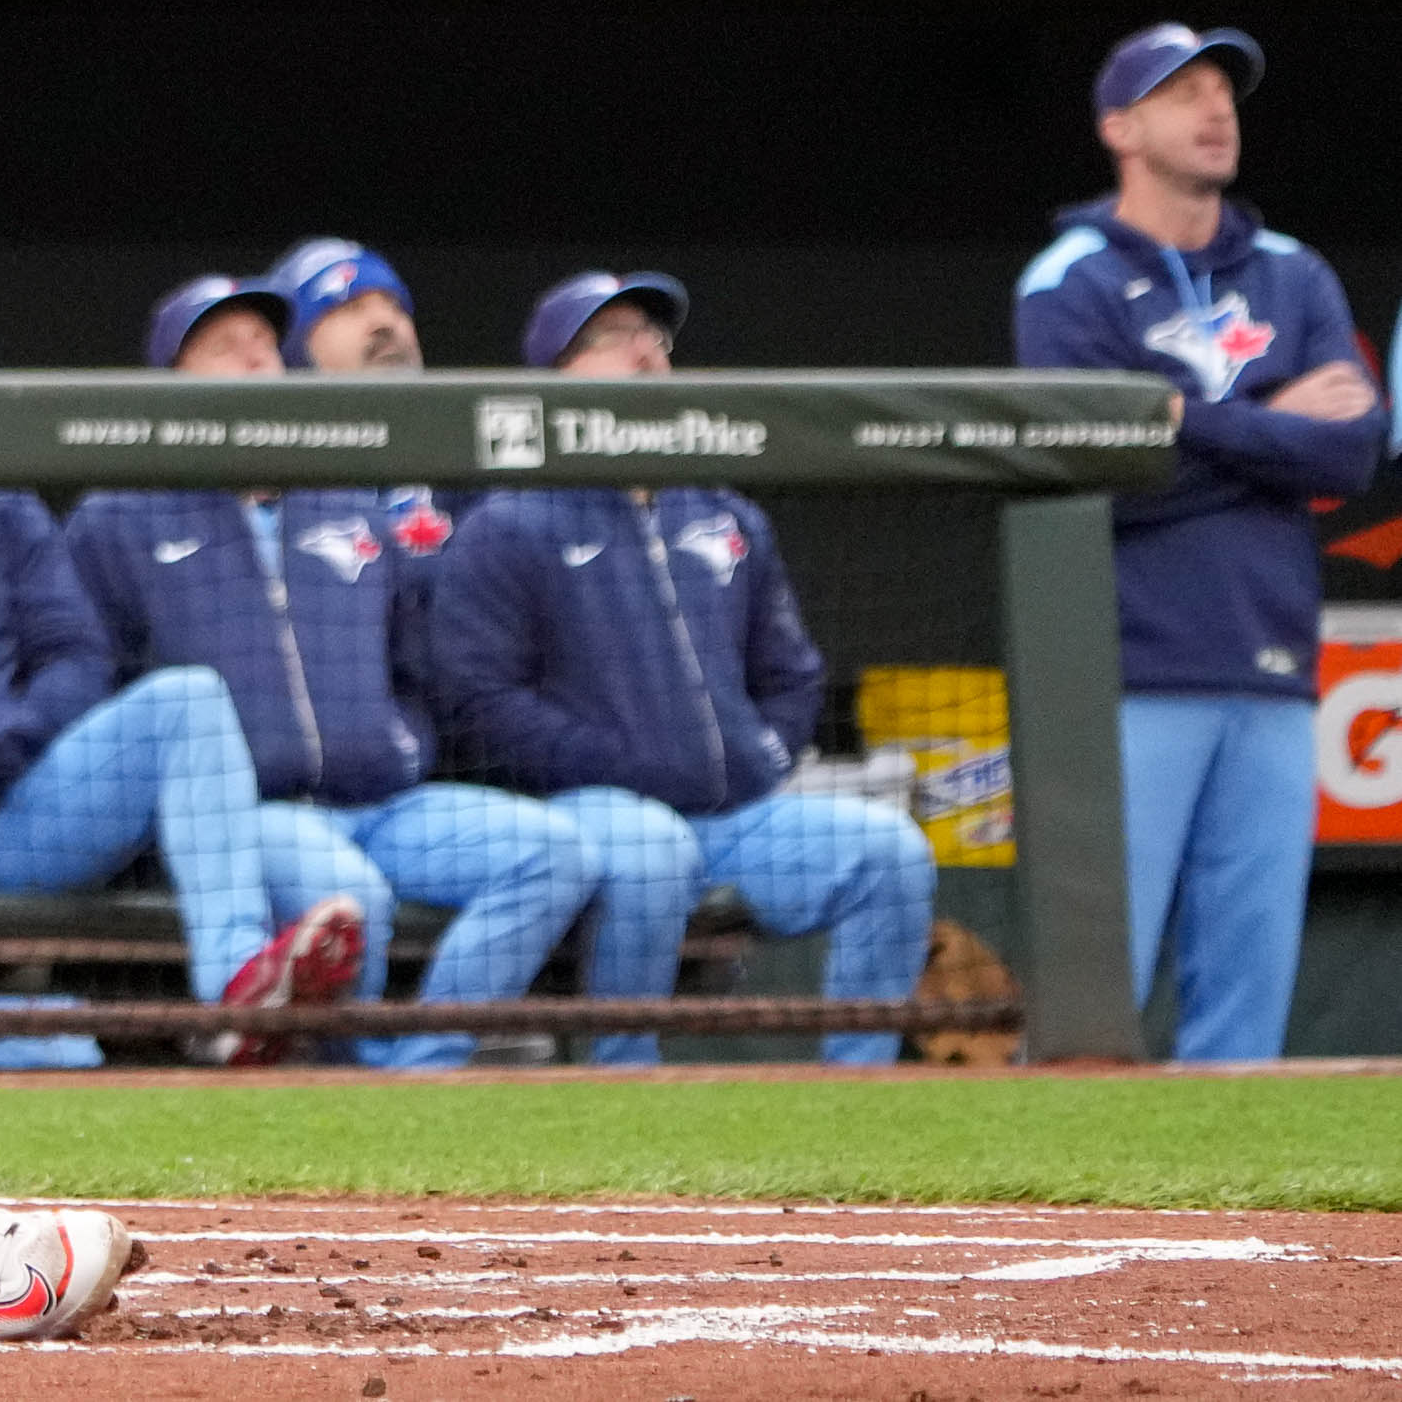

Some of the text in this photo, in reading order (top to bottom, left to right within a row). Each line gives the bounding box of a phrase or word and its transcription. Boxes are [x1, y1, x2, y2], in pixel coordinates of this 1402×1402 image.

[57, 418, 390, 448] INVEST WITH CONFIDENCE
[852, 421, 946, 448] INVEST
[953, 421, 1017, 447] WITH
